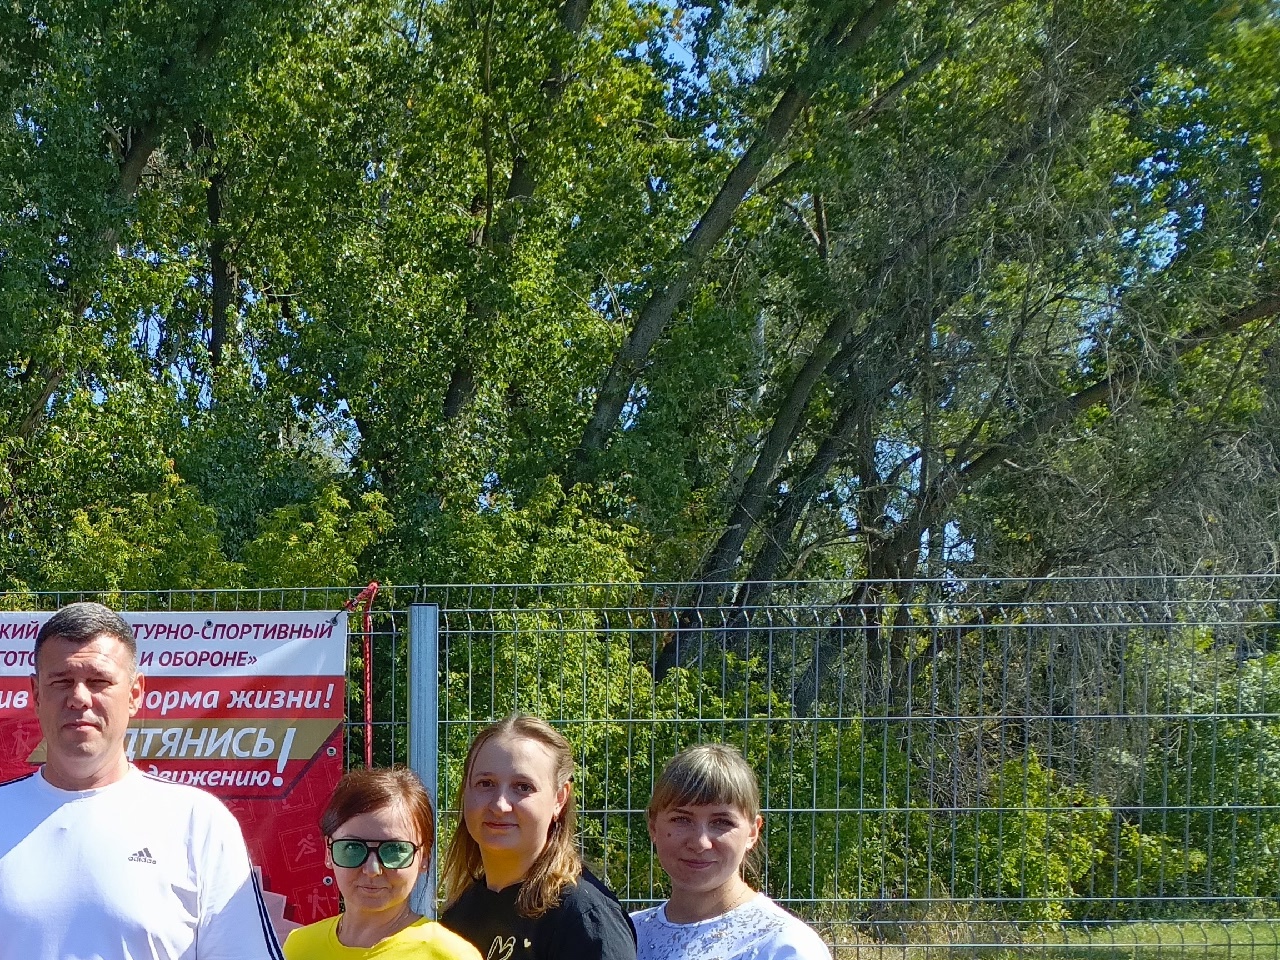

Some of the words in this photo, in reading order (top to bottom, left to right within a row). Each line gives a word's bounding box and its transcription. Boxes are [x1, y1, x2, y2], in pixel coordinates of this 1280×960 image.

[131, 621, 334, 640] ТУРНО-СПОРТИВНЫЙ
[158, 650, 258, 667] ОБОРОНЕ»
[226, 683, 335, 710] жизни!
[124, 727, 297, 787] ДТЯНИСЬ!
